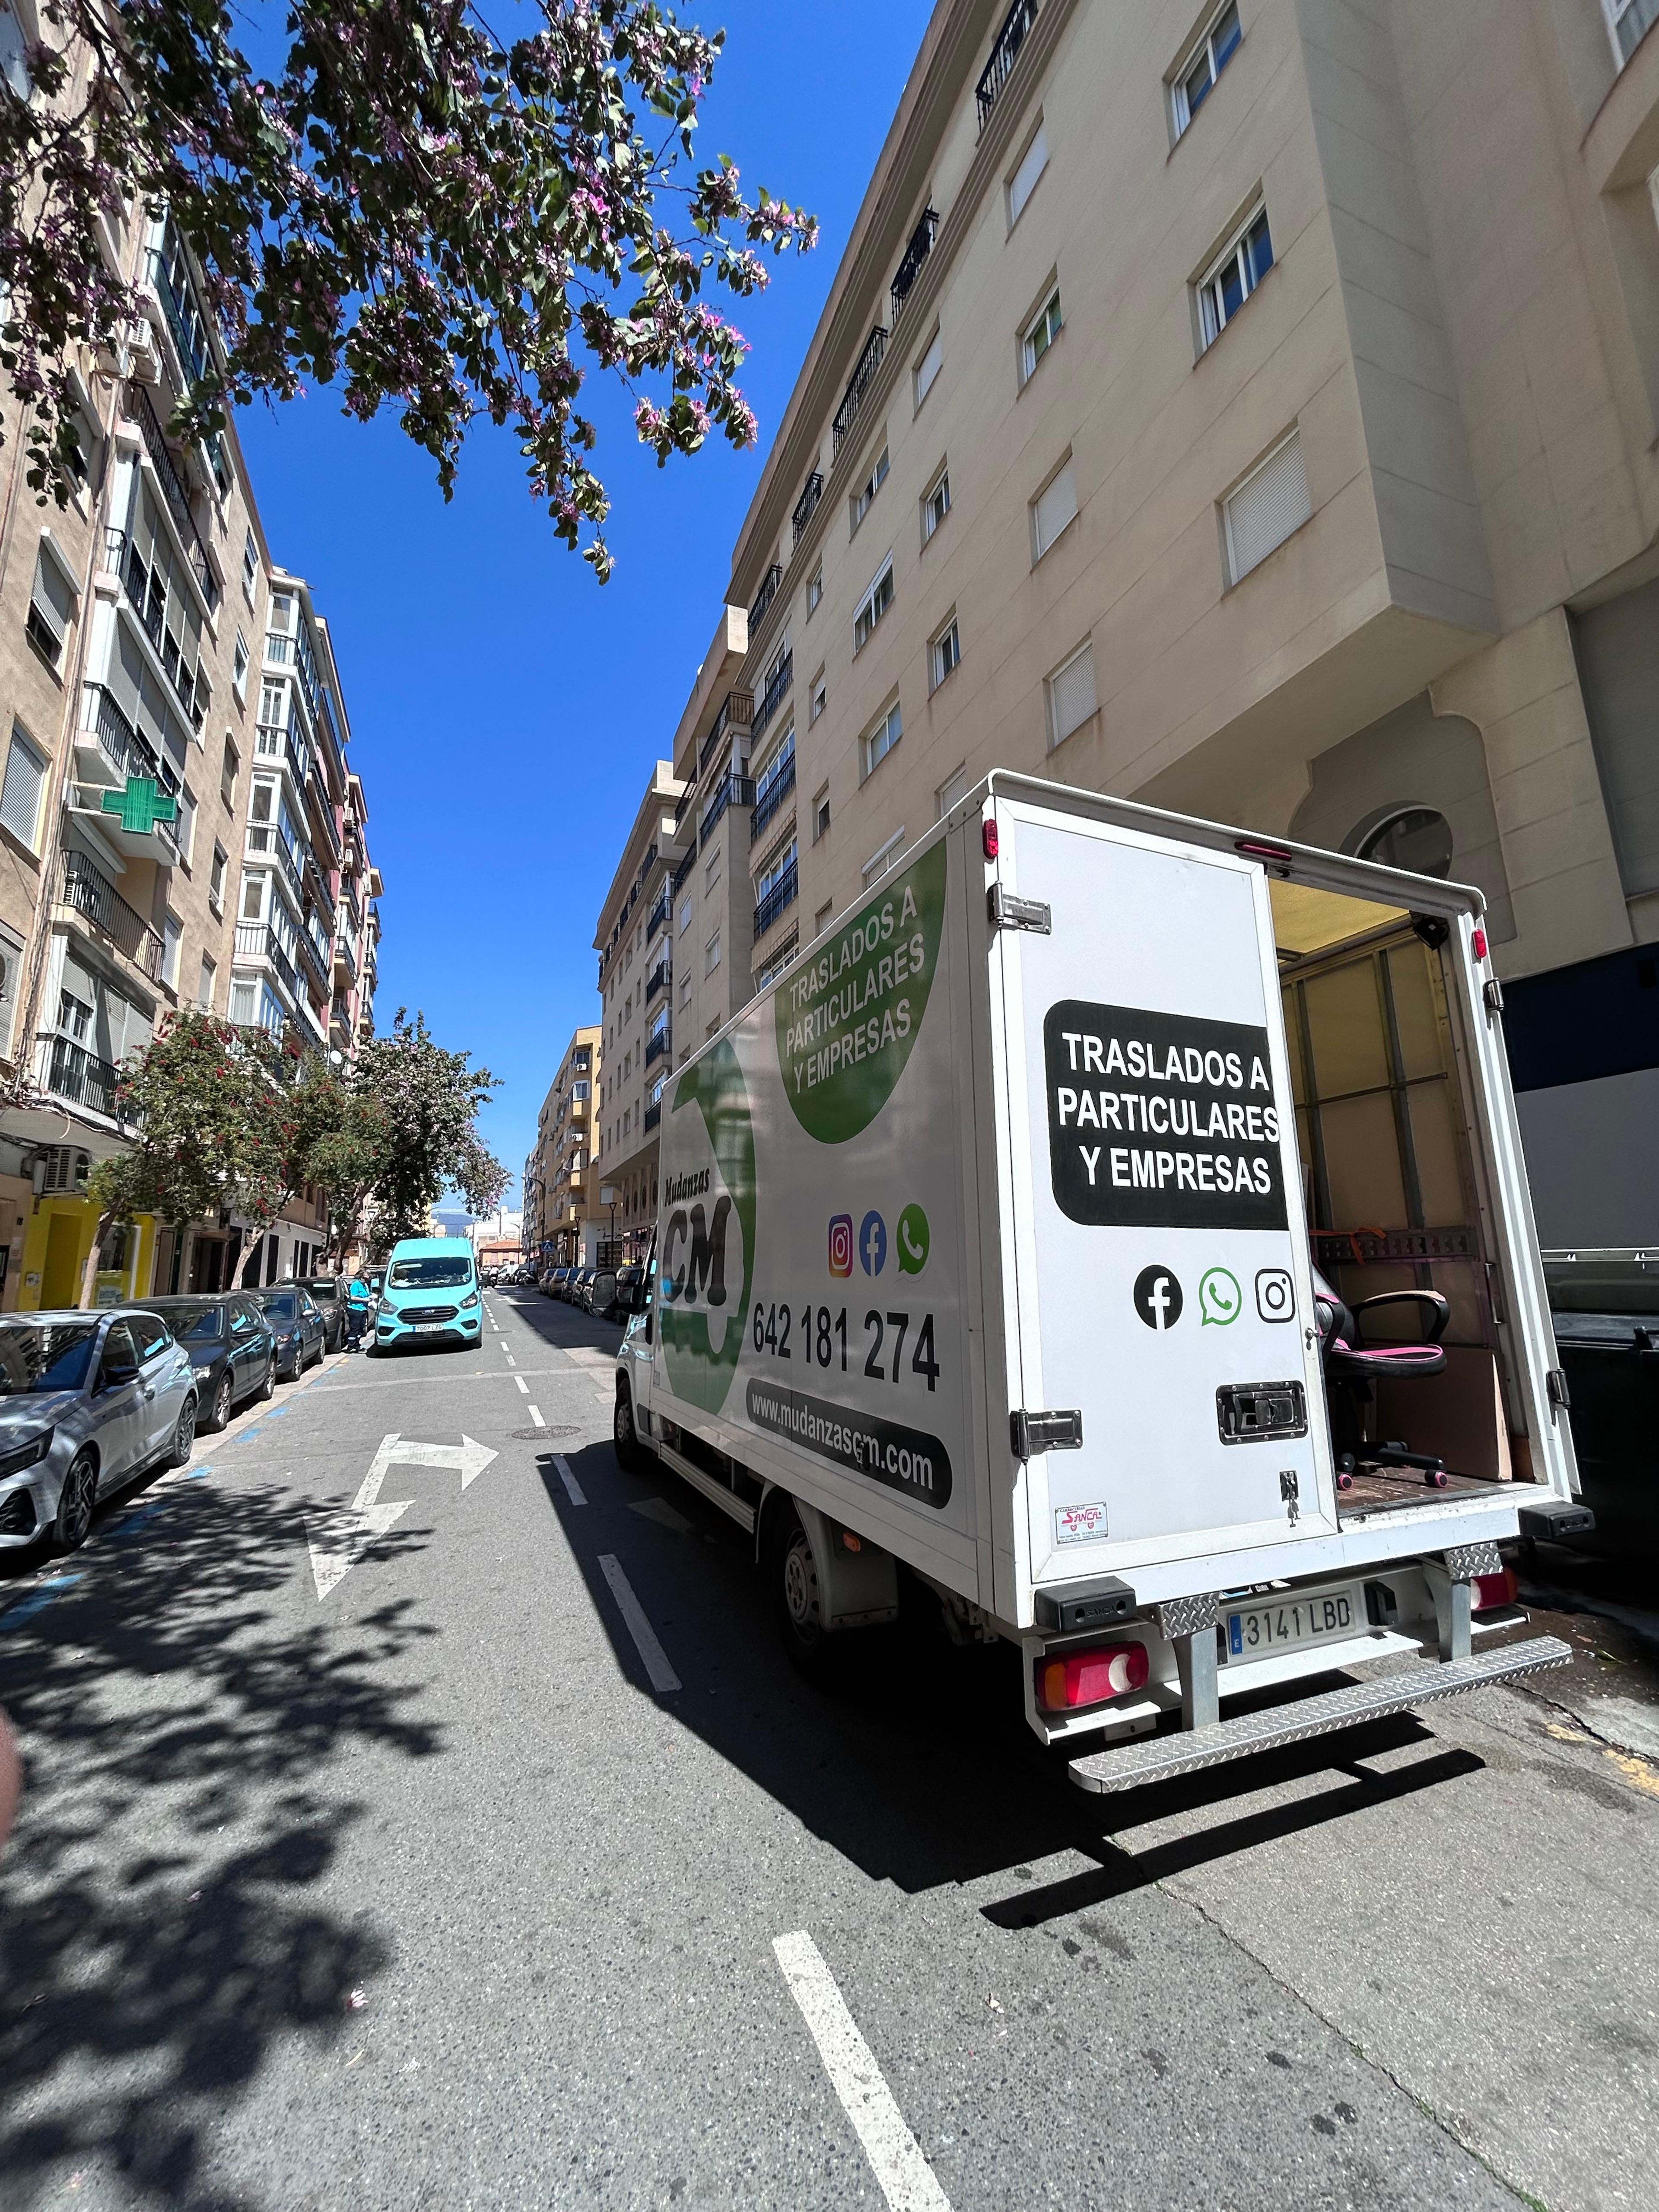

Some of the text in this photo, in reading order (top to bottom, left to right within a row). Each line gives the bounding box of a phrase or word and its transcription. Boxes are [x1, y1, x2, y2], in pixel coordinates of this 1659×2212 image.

[790, 885, 917, 1012] TRASLADOS A
[786, 933, 925, 1057] PARTICULARES
[794, 998, 911, 1093] Y EMPRESAS
[1062, 1032, 1270, 1091] TRASLADOS A
[1058, 1087, 1280, 1143] PARTICULARES
[664, 1168, 710, 1207] Mudanzas
[1078, 1145, 1271, 1194] Y EMPRESAS
[663, 1195, 731, 1306] CM
[753, 1302, 940, 1392] 642 181 274
[752, 1393, 933, 1490] www.mudanzascm.com
[1234, 1598, 1350, 1647] E 3141 LBD
